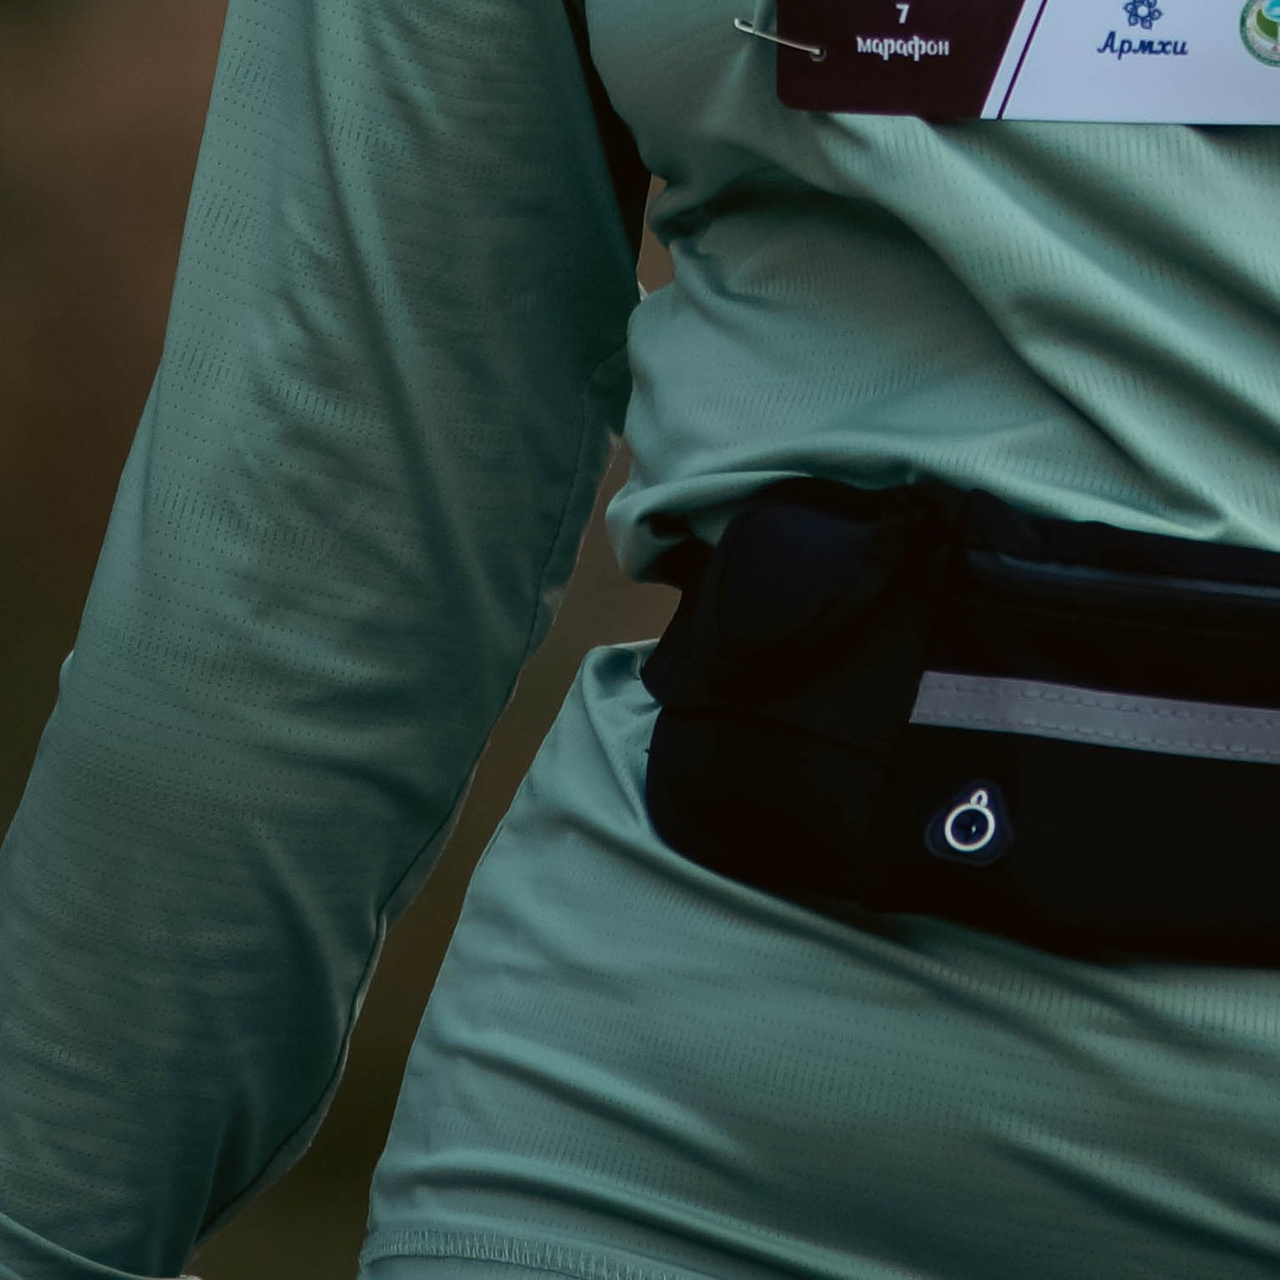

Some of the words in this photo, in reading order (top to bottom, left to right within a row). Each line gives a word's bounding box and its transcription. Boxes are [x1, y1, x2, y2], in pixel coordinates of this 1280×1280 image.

[896, 3, 910, 24] 7
[856, 35, 951, 62] марафон
[1097, 31, 1188, 60] Армхи
